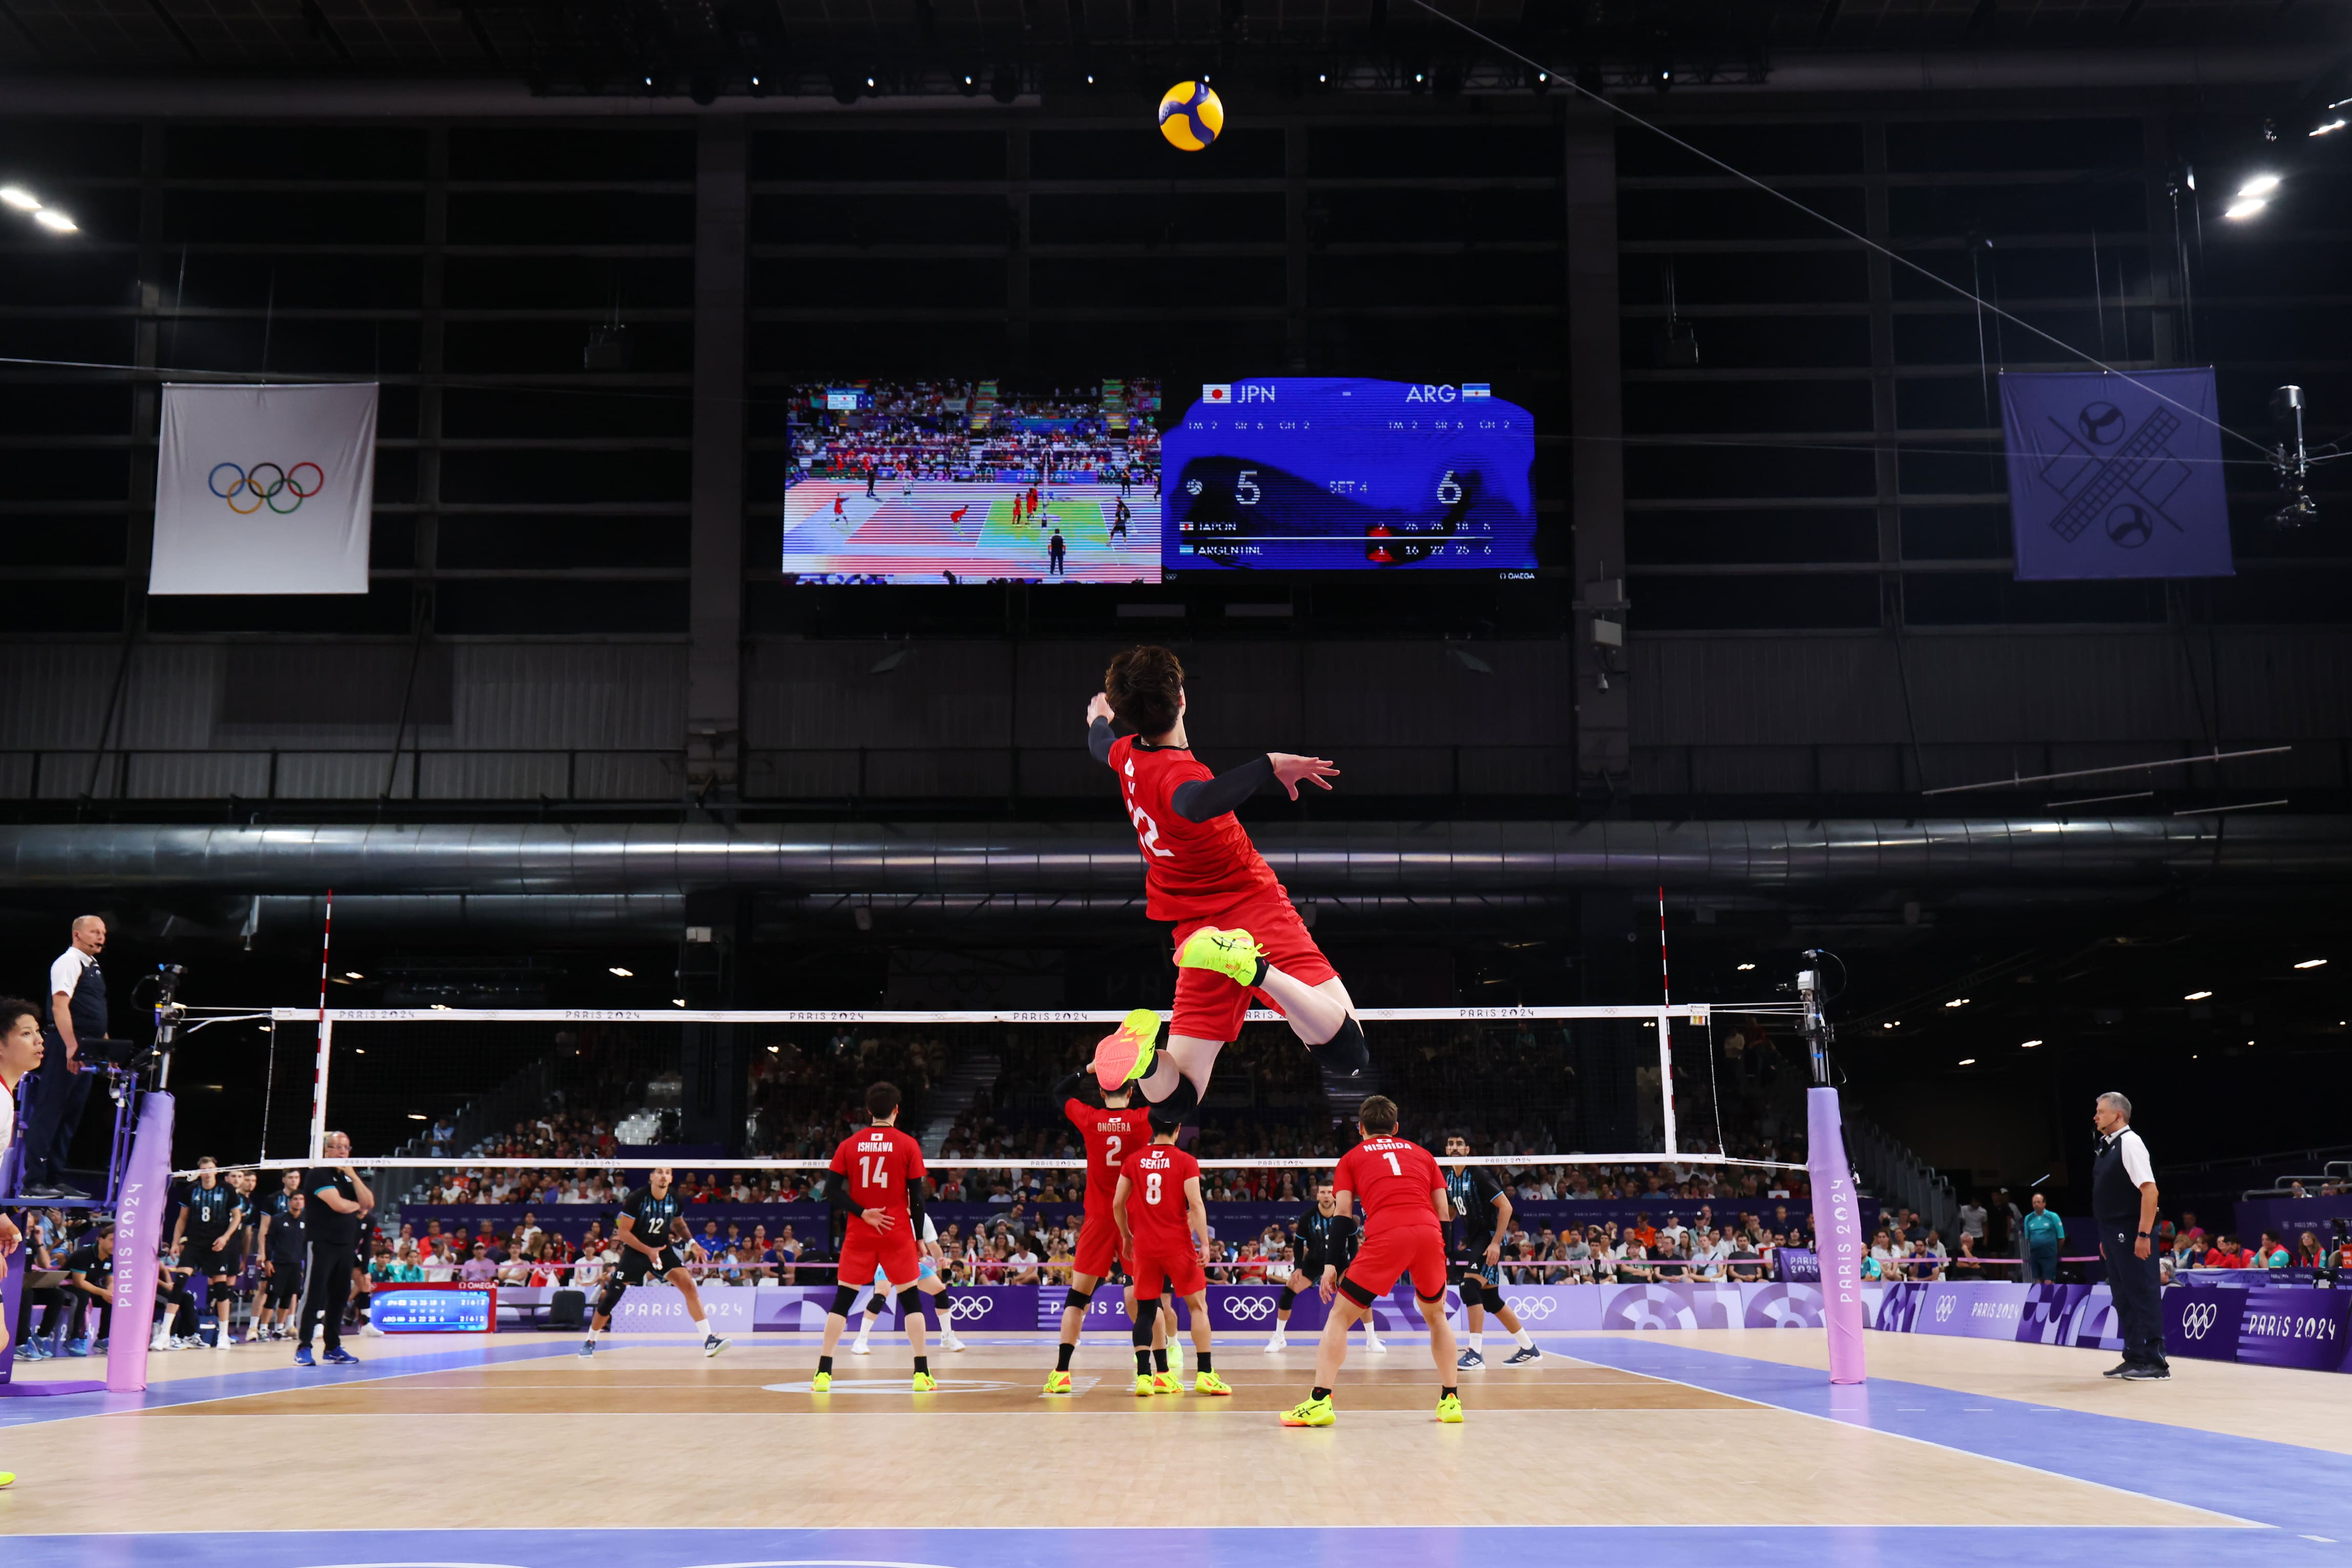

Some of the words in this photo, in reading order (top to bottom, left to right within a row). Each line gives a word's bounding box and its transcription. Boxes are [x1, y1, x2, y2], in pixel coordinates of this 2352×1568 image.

[1237, 385, 1275, 403] JPN
[1406, 384, 1456, 403] ARG
[1235, 470, 1261, 504] 5
[1330, 481, 1355, 494] SET
[1360, 481, 1368, 494] 4
[1436, 470, 1462, 504] 6
[1199, 521, 1237, 531] JAPON
[1455, 521, 1469, 531] 18
[1378, 546, 1385, 555] 1
[1406, 546, 1419, 555] 16
[1430, 546, 1444, 555] 22
[1484, 546, 1491, 555] 6
[1097, 1122, 1131, 1132] ONODERA
[857, 1142, 893, 1152] ISHIKAWA
[1106, 1135, 1122, 1167] 2
[1363, 1142, 1412, 1152] NISHIDA
[1140, 1157, 1170, 1170] SEKITA
[1382, 1152, 1402, 1175] 1
[859, 1156, 888, 1188] 14
[1146, 1173, 1162, 1205] 8
[119, 1184, 143, 1238] 2024
[201, 1206, 211, 1222] 8
[1452, 1196, 1467, 1216] 18
[1831, 1179, 1851, 1234] 2024
[647, 1217, 664, 1234] 12
[1790, 1256, 1817, 1265] PARIS
[616, 1271, 625, 1280] 12
[1791, 1265, 1818, 1273] 2024
[703, 1303, 743, 1316] 024
[1050, 1301, 1107, 1315] PIS
[1996, 1303, 2019, 1319] 2024
[2294, 1316, 2336, 1340] 2024
